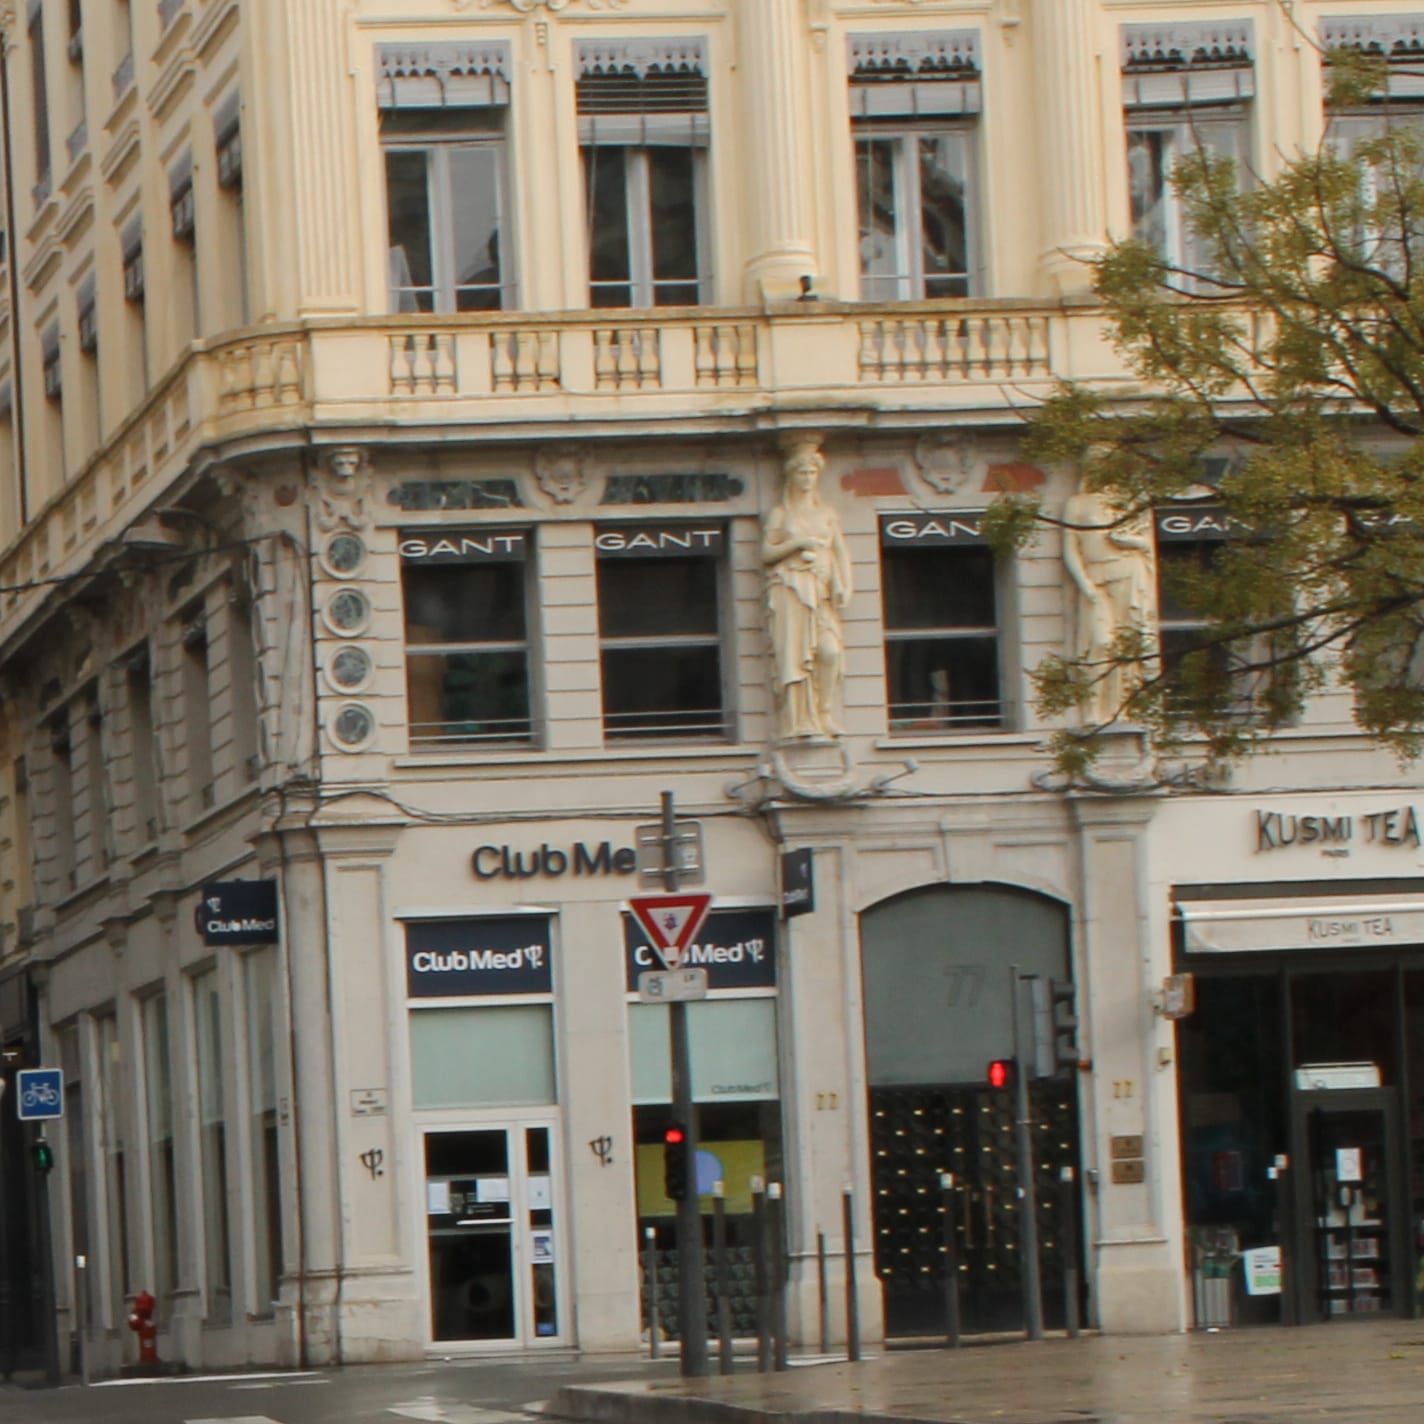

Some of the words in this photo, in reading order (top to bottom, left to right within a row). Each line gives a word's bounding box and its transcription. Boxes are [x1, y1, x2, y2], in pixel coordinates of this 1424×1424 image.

[885, 519, 988, 539] GAN
[399, 536, 523, 557] GANT
[594, 530, 721, 551] GANT
[1253, 809, 1352, 855] KUSMI
[1360, 805, 1422, 848] TEA
[573, 841, 638, 876] Me
[1307, 917, 1358, 941] KUSMI
[1362, 917, 1393, 937] TEA
